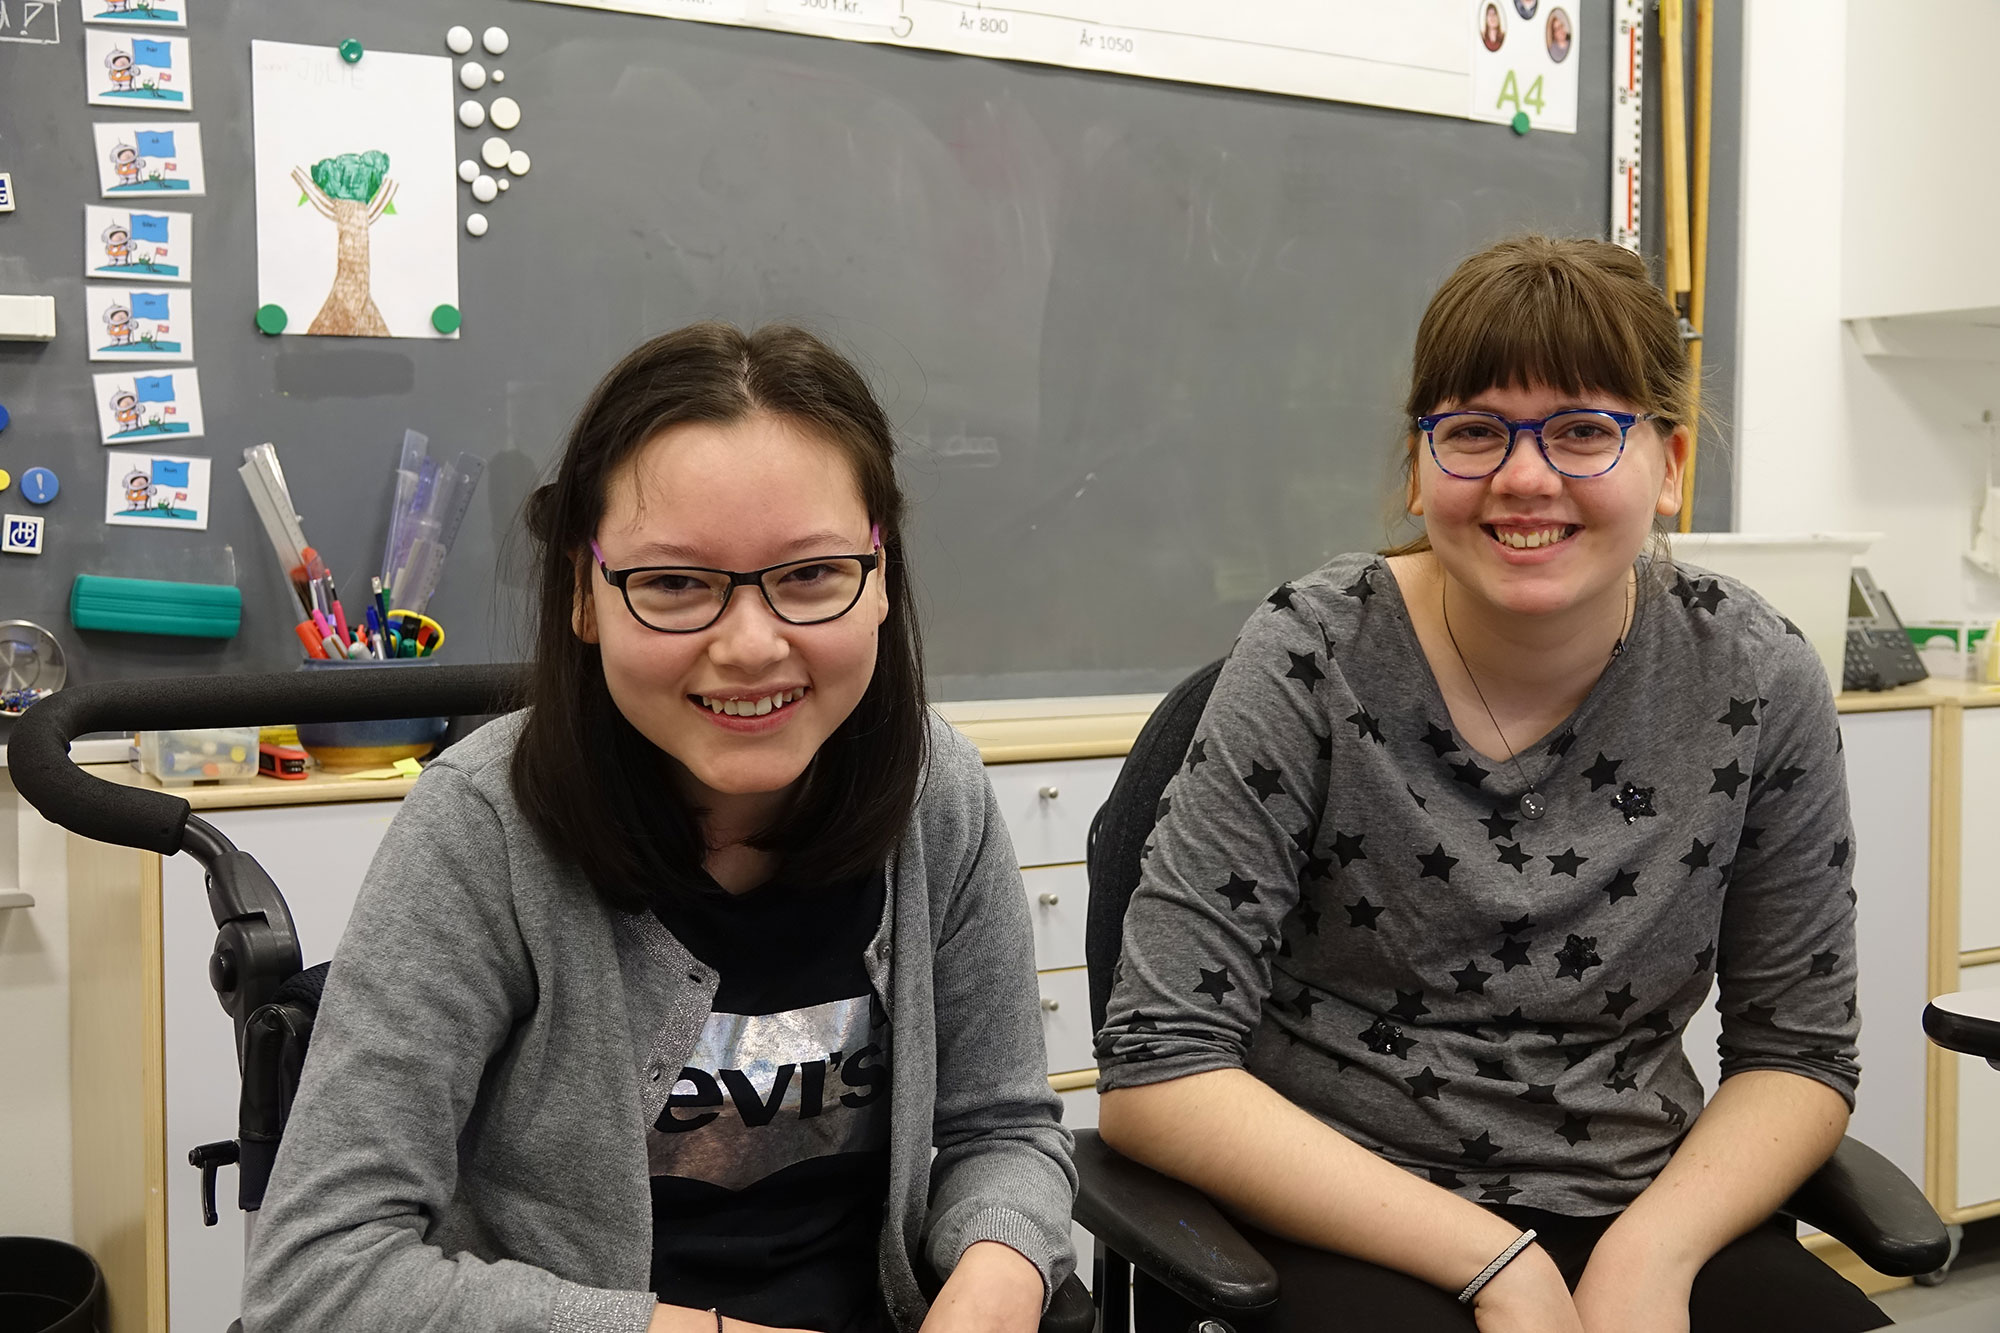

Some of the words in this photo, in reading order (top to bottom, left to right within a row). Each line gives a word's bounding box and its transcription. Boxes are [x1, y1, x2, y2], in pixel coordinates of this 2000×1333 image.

[960, 11, 974, 30] År
[980, 17, 1009, 34] 800
[1079, 29, 1094, 47] År
[1099, 35, 1134, 53] 1050
[1496, 69, 1545, 115] A4
[653, 1043, 888, 1133] evi's
